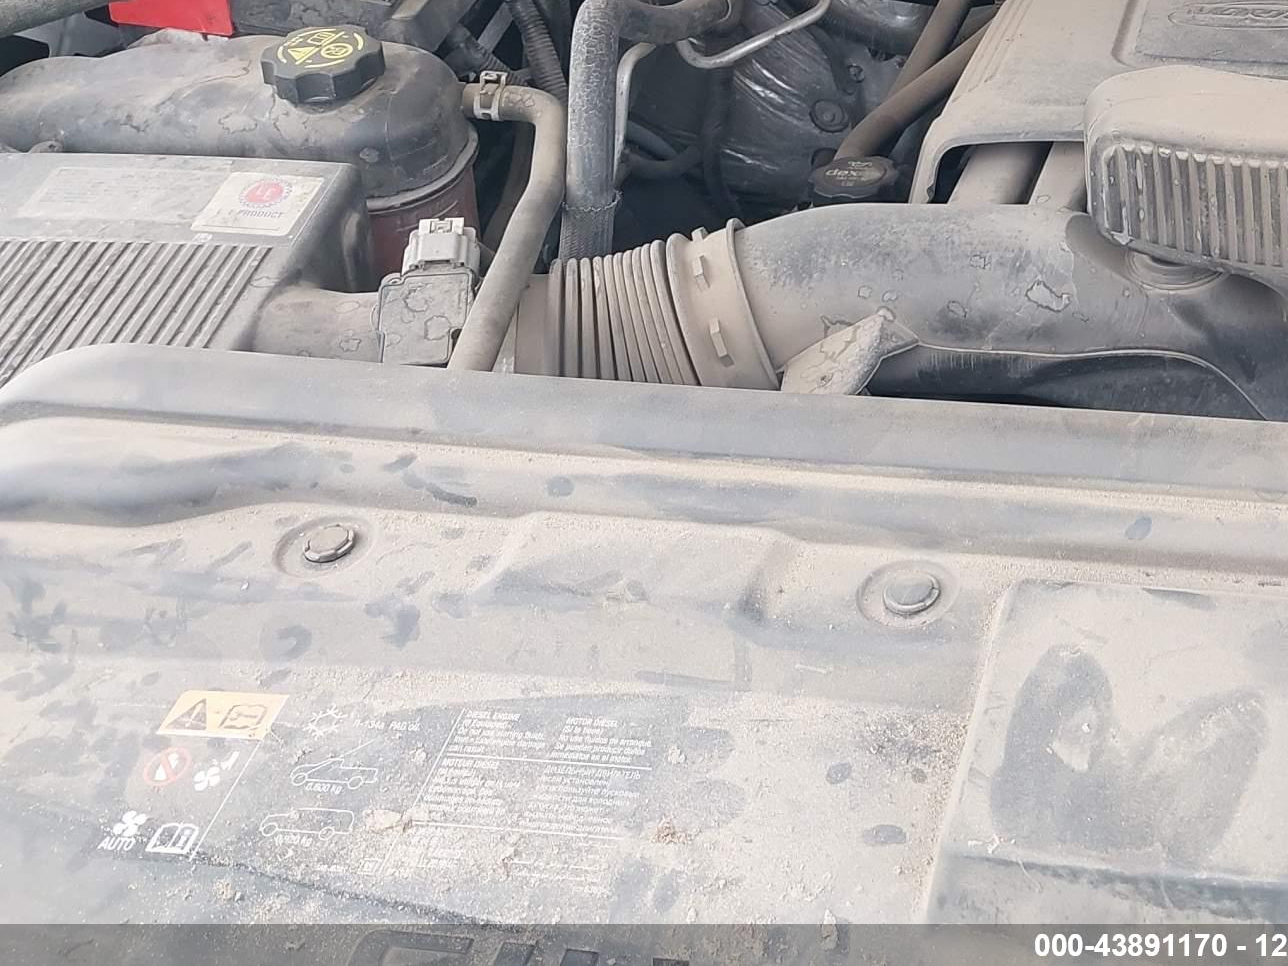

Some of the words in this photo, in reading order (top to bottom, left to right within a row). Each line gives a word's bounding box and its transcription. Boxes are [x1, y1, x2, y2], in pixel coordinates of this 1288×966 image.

[237, 209, 285, 219] PRODUCT
[566, 717, 592, 725] MOTOR
[97, 836, 136, 851] AUTO
